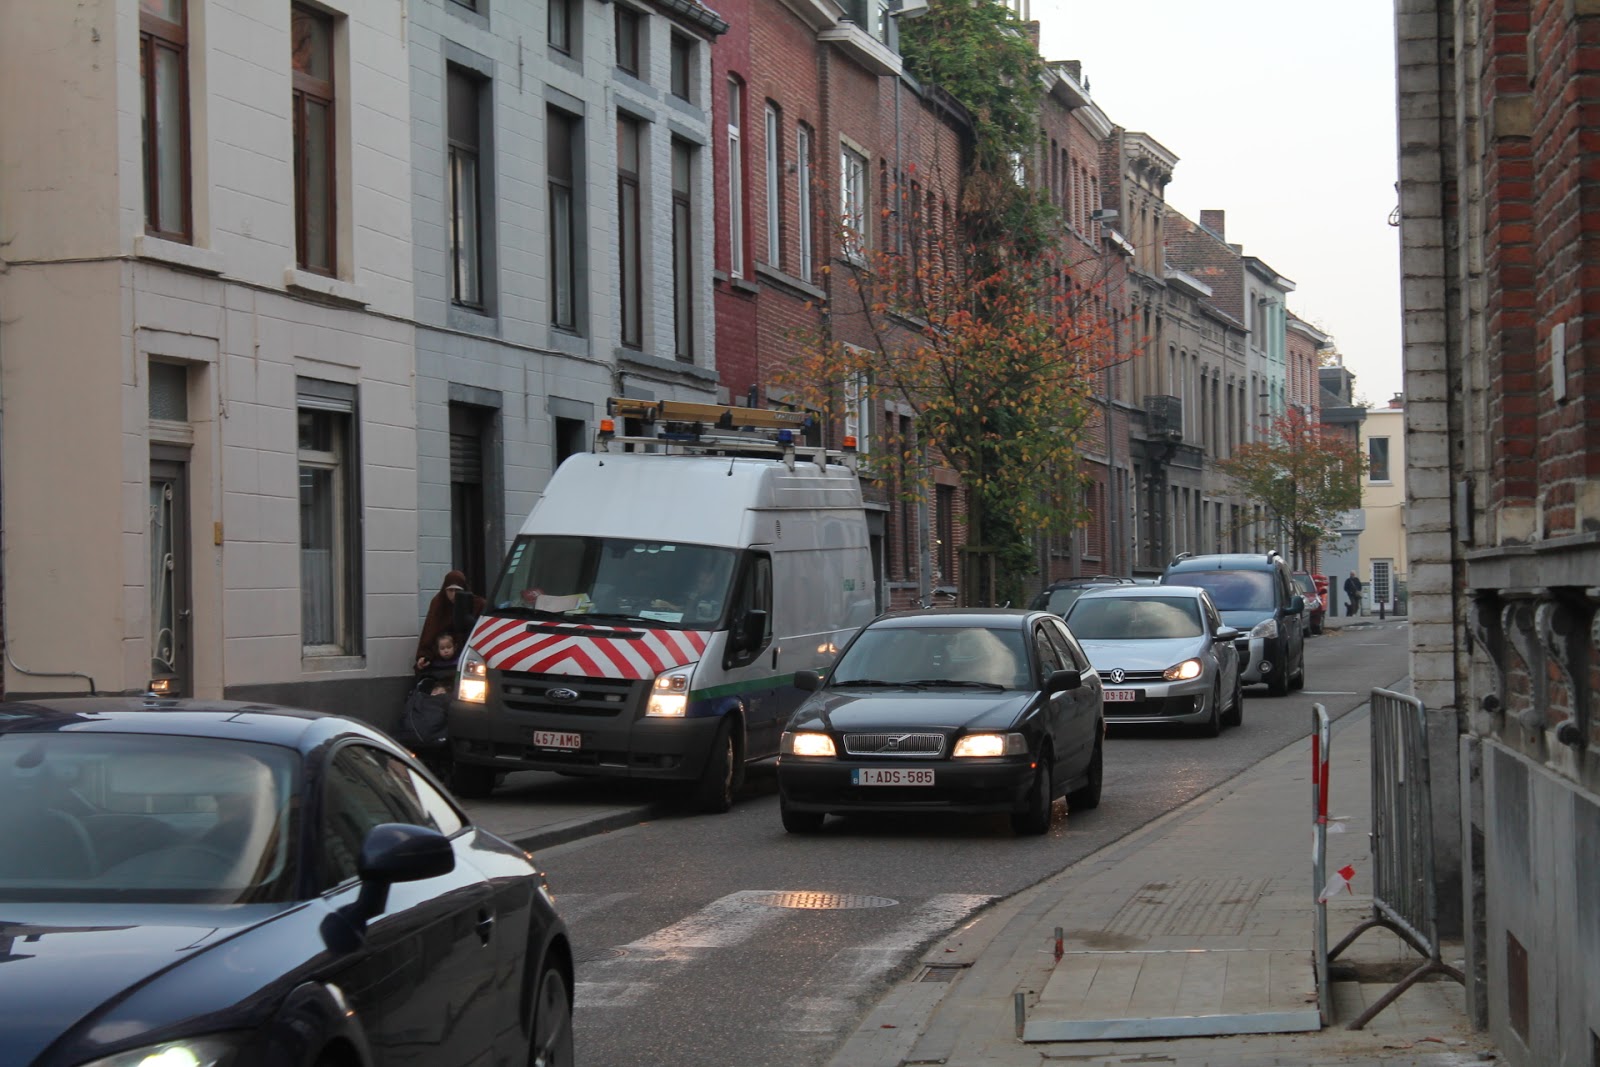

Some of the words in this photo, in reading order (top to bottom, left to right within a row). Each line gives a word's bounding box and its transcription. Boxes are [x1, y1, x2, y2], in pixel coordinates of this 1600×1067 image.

[1103, 691, 1134, 701] 09-BZX
[535, 732, 580, 747] 467-AMG
[863, 770, 933, 784] 1-ADS-585
